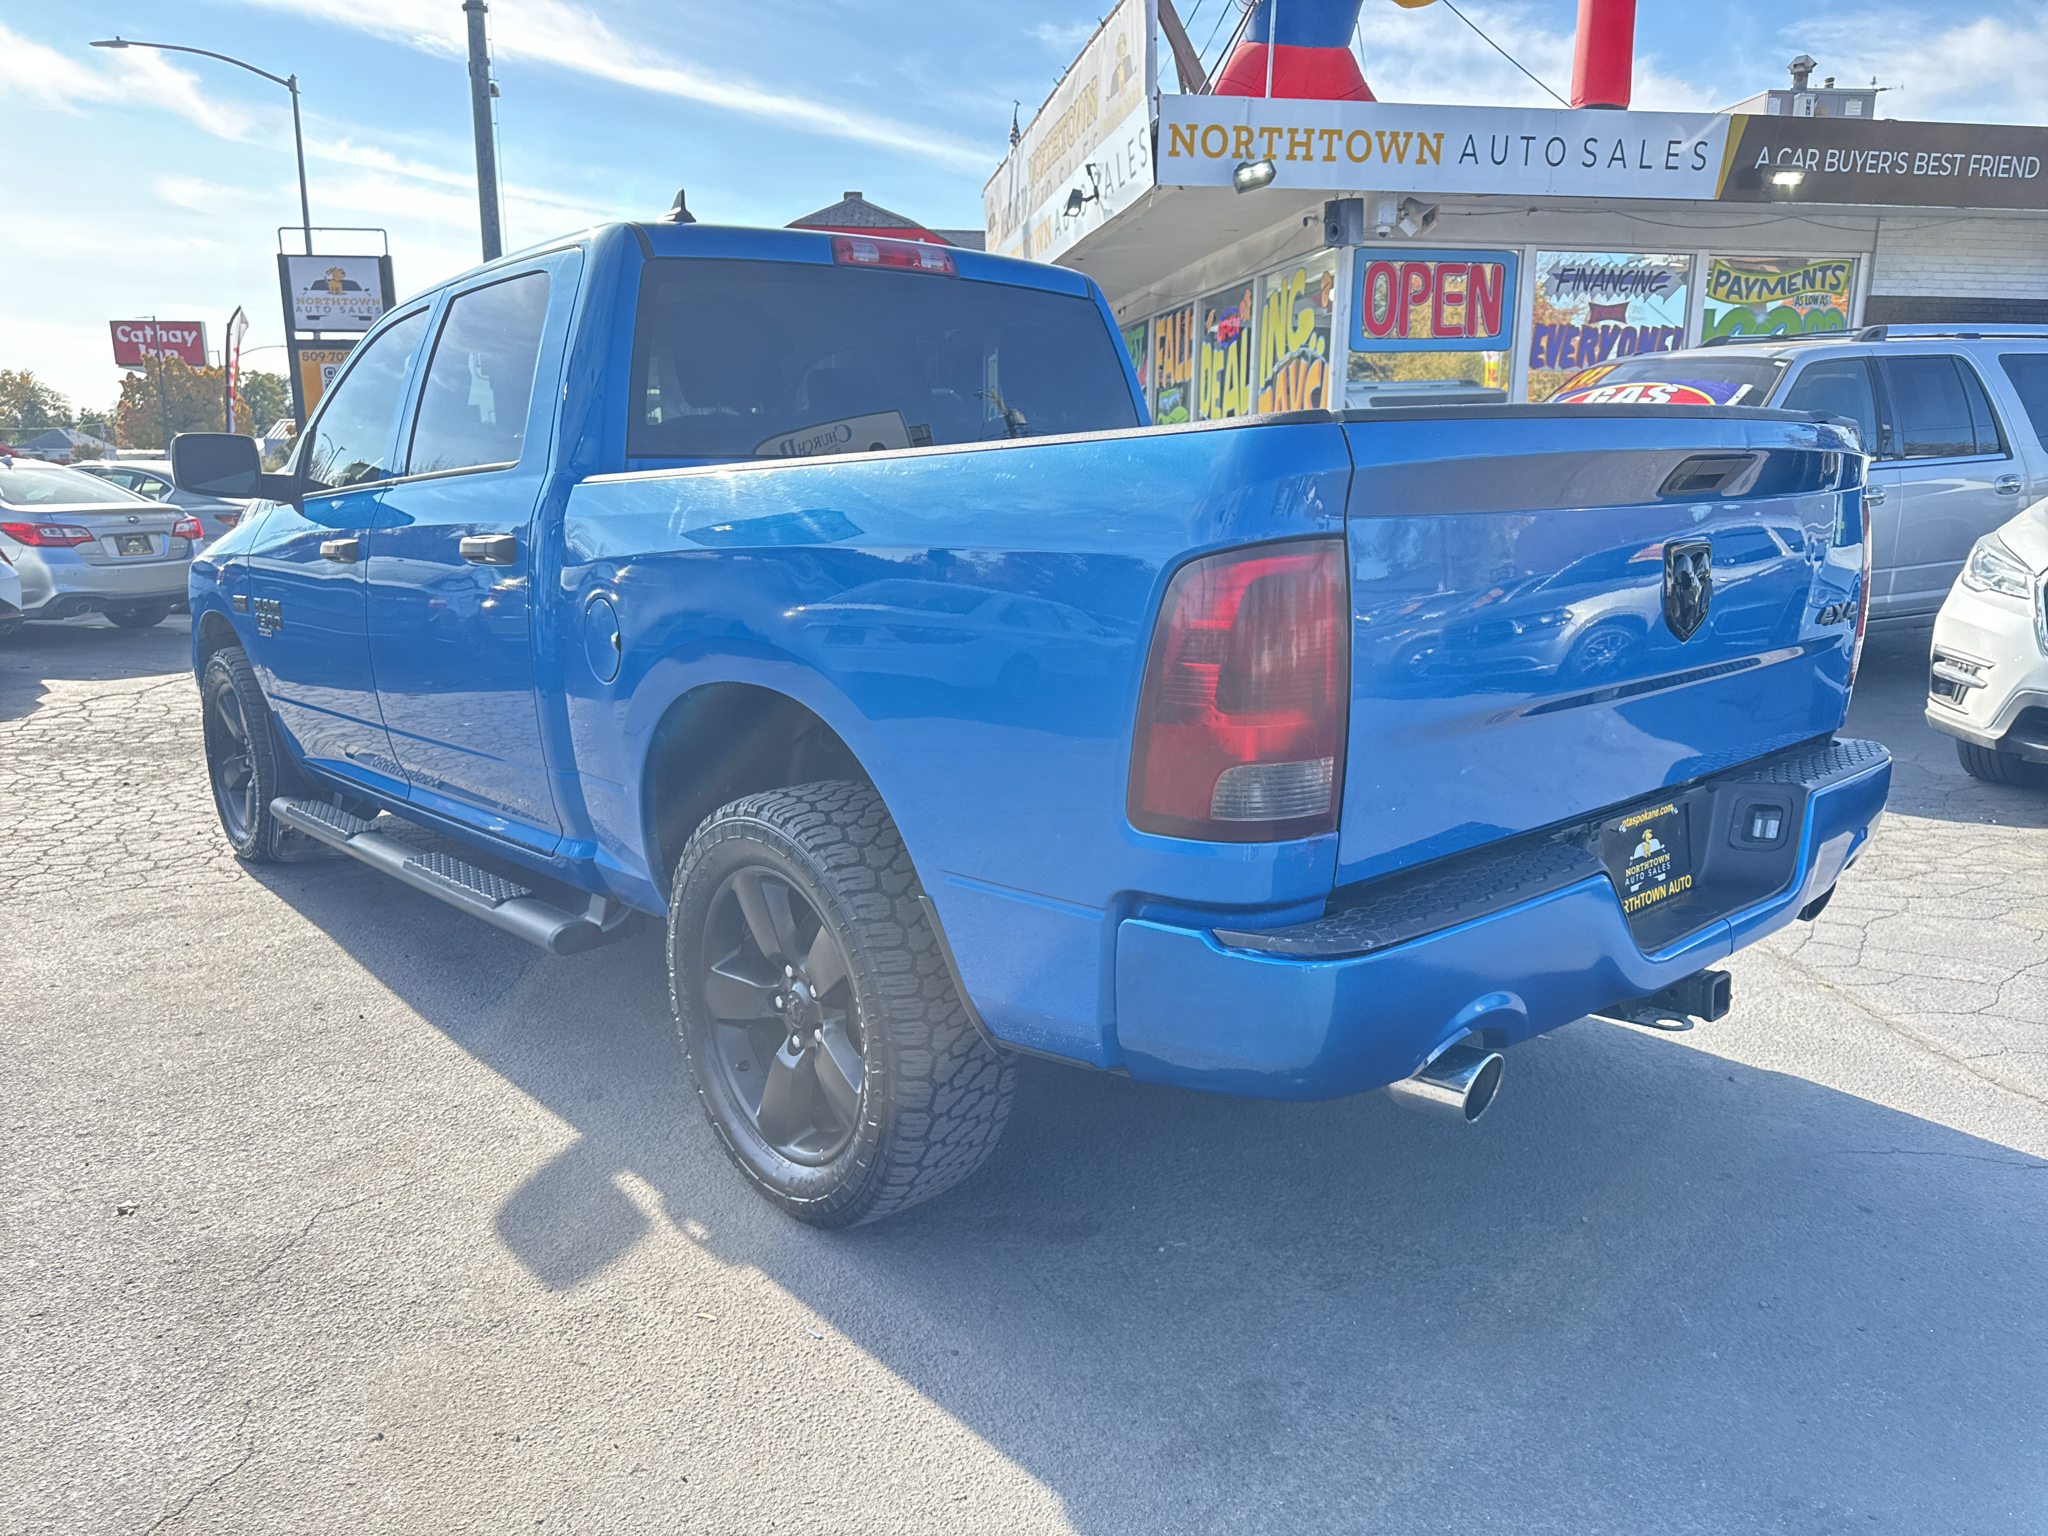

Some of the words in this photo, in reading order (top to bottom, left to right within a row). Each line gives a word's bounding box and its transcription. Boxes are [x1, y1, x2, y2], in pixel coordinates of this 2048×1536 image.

[1168, 123, 1445, 165] NORTHTOWN
[1458, 133, 1567, 167] AUTO
[1581, 137, 1709, 171] SALES
[1754, 146, 1770, 169] A
[1777, 147, 1820, 172] CAR
[1824, 149, 1909, 174] BUYER'S
[1913, 152, 1966, 176] BEST
[1968, 154, 2041, 179] FRIEND
[1556, 267, 1668, 293] FINANCING
[1712, 264, 1846, 300] PAYMENTS
[296, 297, 380, 306] NORTHTOWN
[296, 306, 331, 314] AUTO
[340, 306, 382, 314] SALES
[1362, 260, 1504, 339] OPEN
[1804, 295, 1820, 306] LOW
[116, 324, 198, 347] Cathay
[1217, 313, 1239, 341] OPEN
[1155, 308, 1194, 388] FALL
[1582, 383, 1679, 404] GAS
[1625, 853, 1671, 877] NORTHTOWN
[1625, 871, 1645, 886] AUTO
[1648, 861, 1671, 877] SALES
[1668, 874, 1692, 895] AUTO
